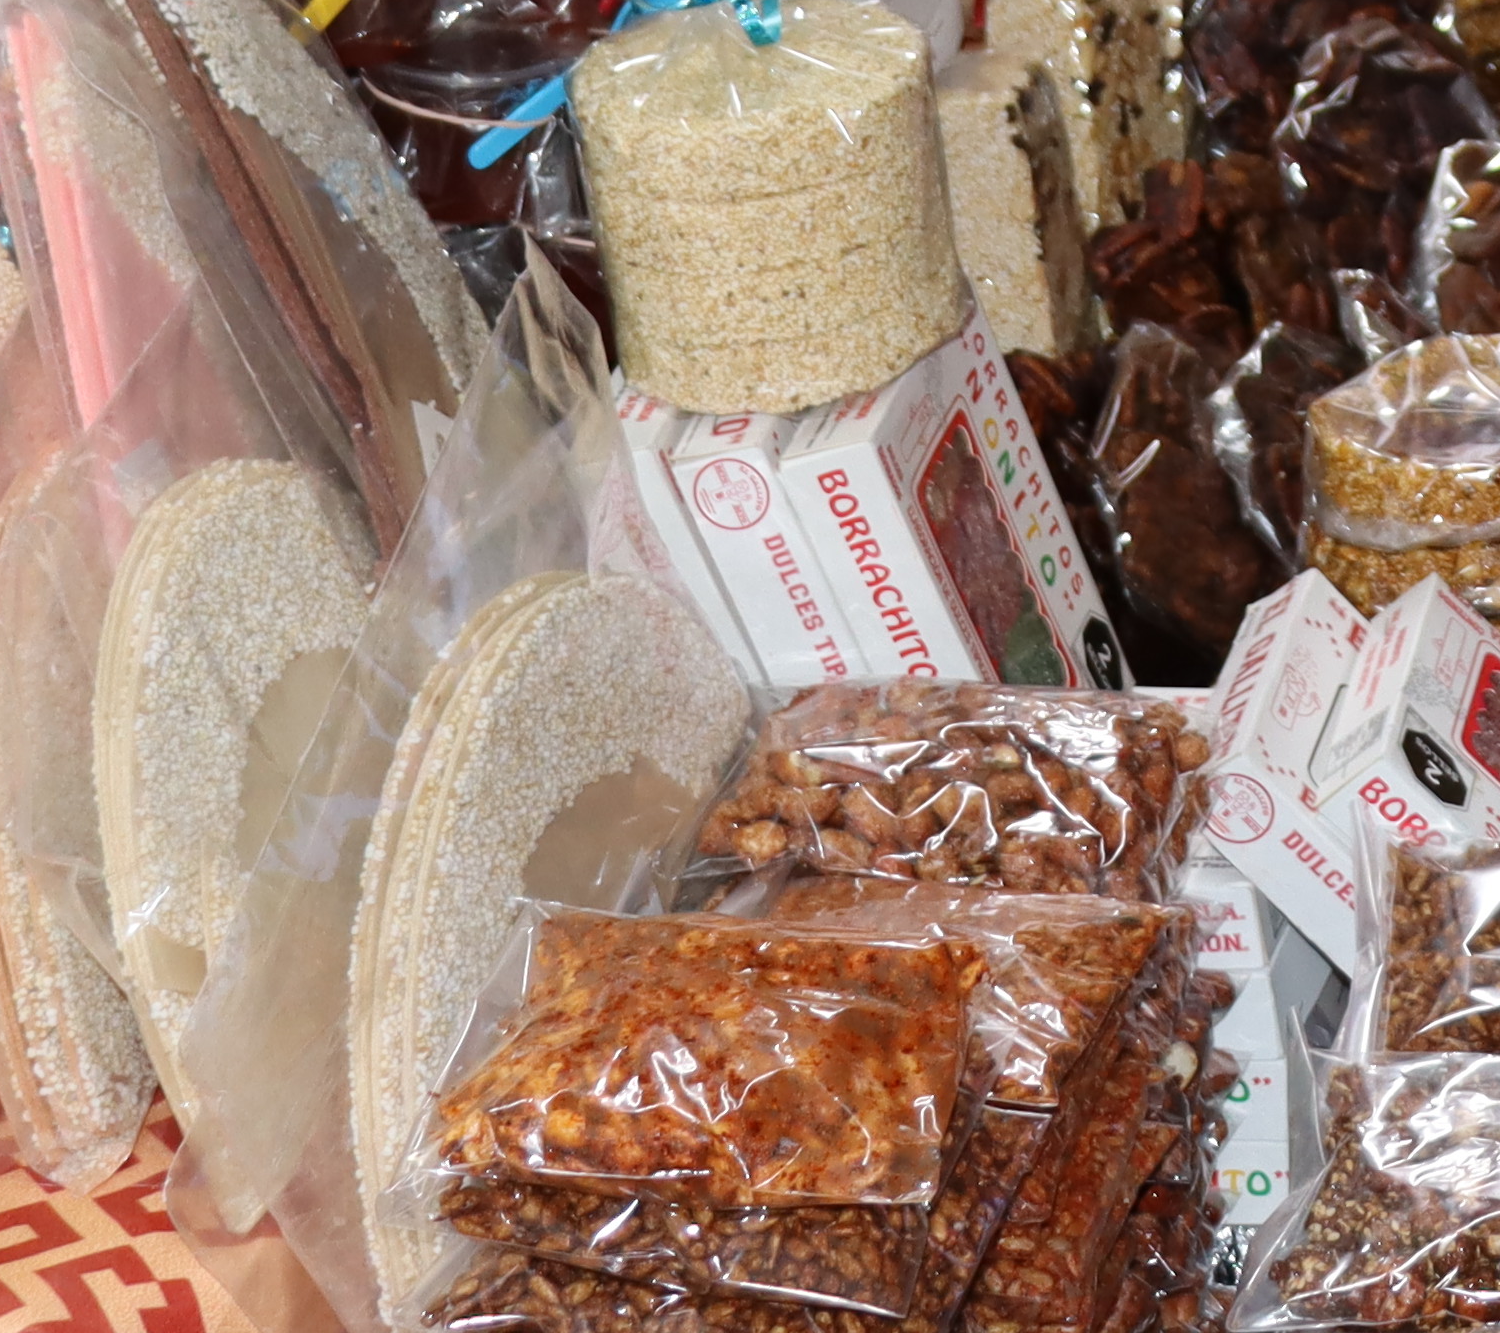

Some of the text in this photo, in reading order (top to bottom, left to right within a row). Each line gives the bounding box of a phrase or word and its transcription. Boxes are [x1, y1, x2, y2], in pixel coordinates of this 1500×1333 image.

[969, 331, 1084, 596] ORRACHITOS
[762, 533, 850, 683] DULCES TIP
[816, 468, 939, 678] BORRACHITO
[1413, 735, 1461, 783] SELLOS
[1423, 758, 1444, 786] 2
